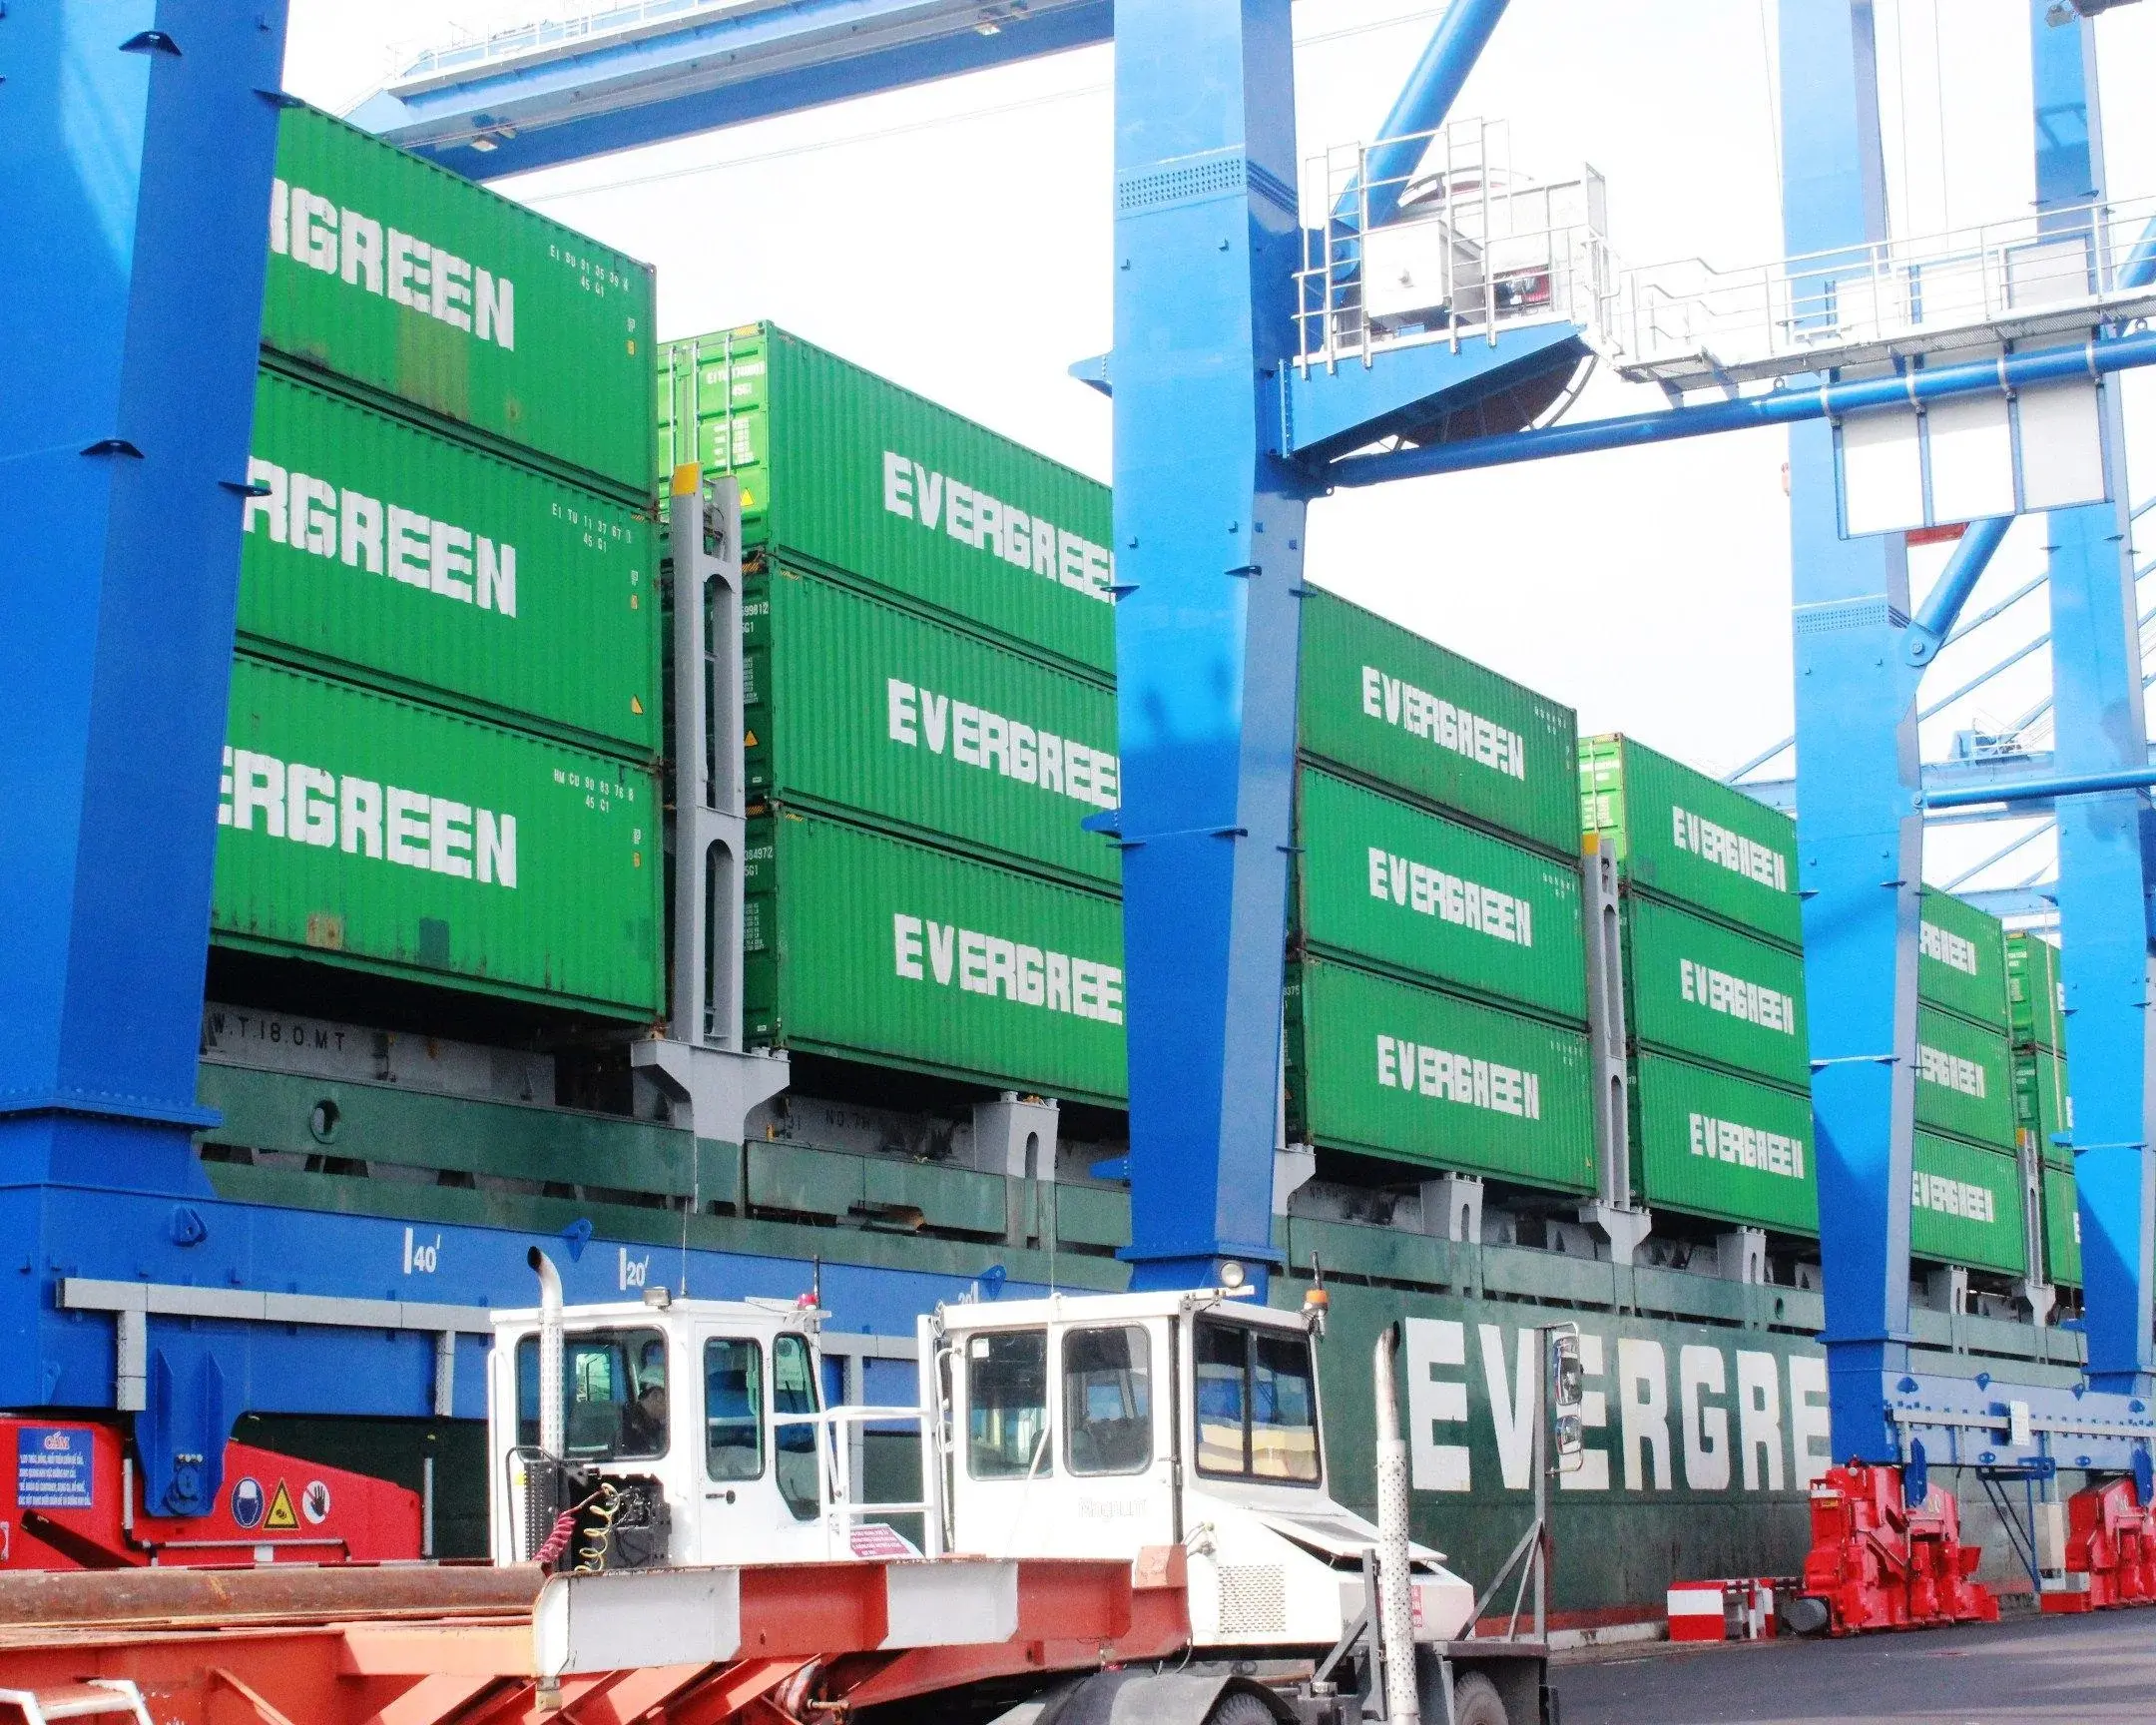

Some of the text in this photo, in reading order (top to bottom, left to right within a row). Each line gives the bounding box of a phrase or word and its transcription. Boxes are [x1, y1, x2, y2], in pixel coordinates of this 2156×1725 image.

[883, 451, 1115, 605] EVERGREE
[888, 678, 1122, 811] EVERGREE
[1362, 666, 1524, 781] EVERGREEN
[585, 795, 595, 809] 45
[1673, 806, 1786, 892] EVERGREEN
[1369, 848, 1532, 947] EVERGREEN
[894, 913, 1123, 1025] EVERGREE
[1681, 958, 1794, 1035] EVERGREEN
[1377, 1034, 1539, 1120] EVERGREEN
[1690, 1113, 1804, 1179] EVERGREEN
